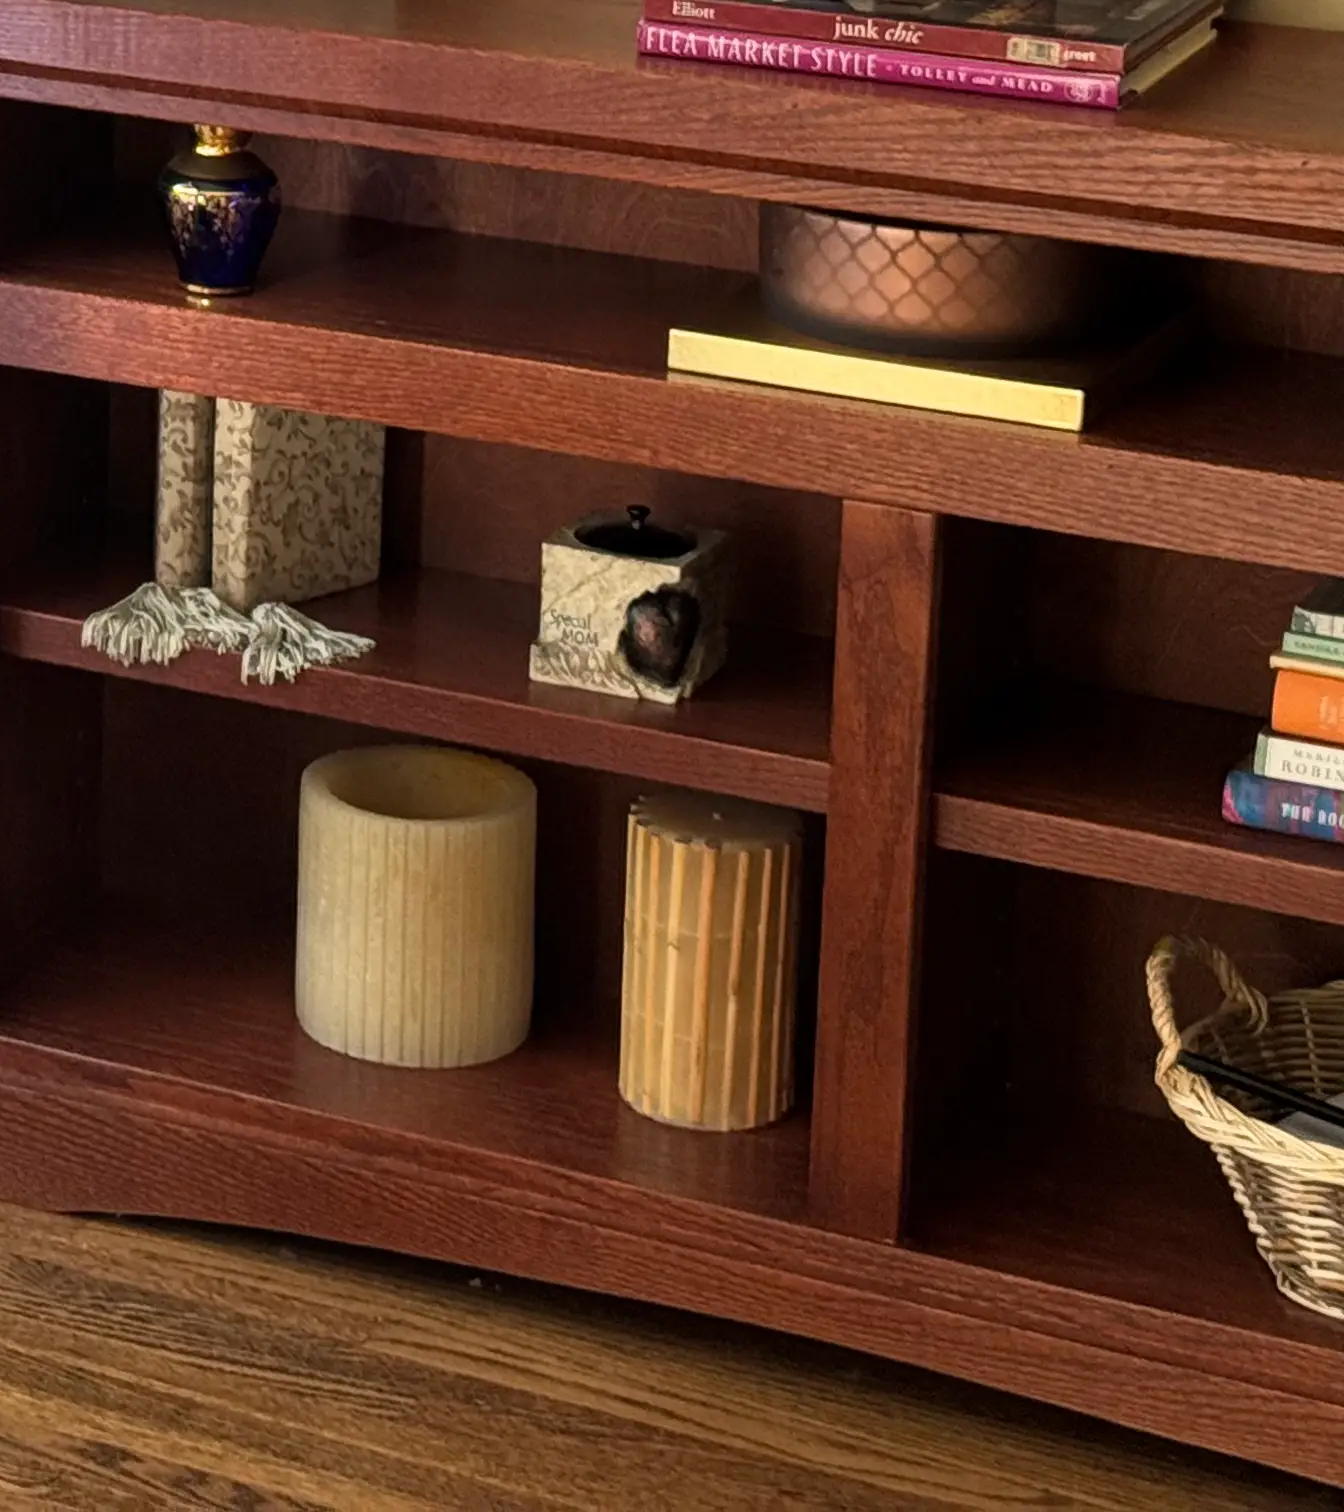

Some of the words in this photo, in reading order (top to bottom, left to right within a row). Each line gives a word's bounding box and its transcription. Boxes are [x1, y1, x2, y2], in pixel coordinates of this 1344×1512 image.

[672, 0, 716, 20] Elliott
[832, 16, 880, 41] junk
[884, 21, 924, 45] chic
[646, 26, 698, 56] FLEA
[707, 35, 802, 69] MARKET
[810, 45, 880, 78] STYLE
[899, 63, 968, 83] TOLLEY
[971, 74, 997, 87] and
[1000, 75, 1054, 94] MEAD
[1293, 749, 1344, 766] MARIL
